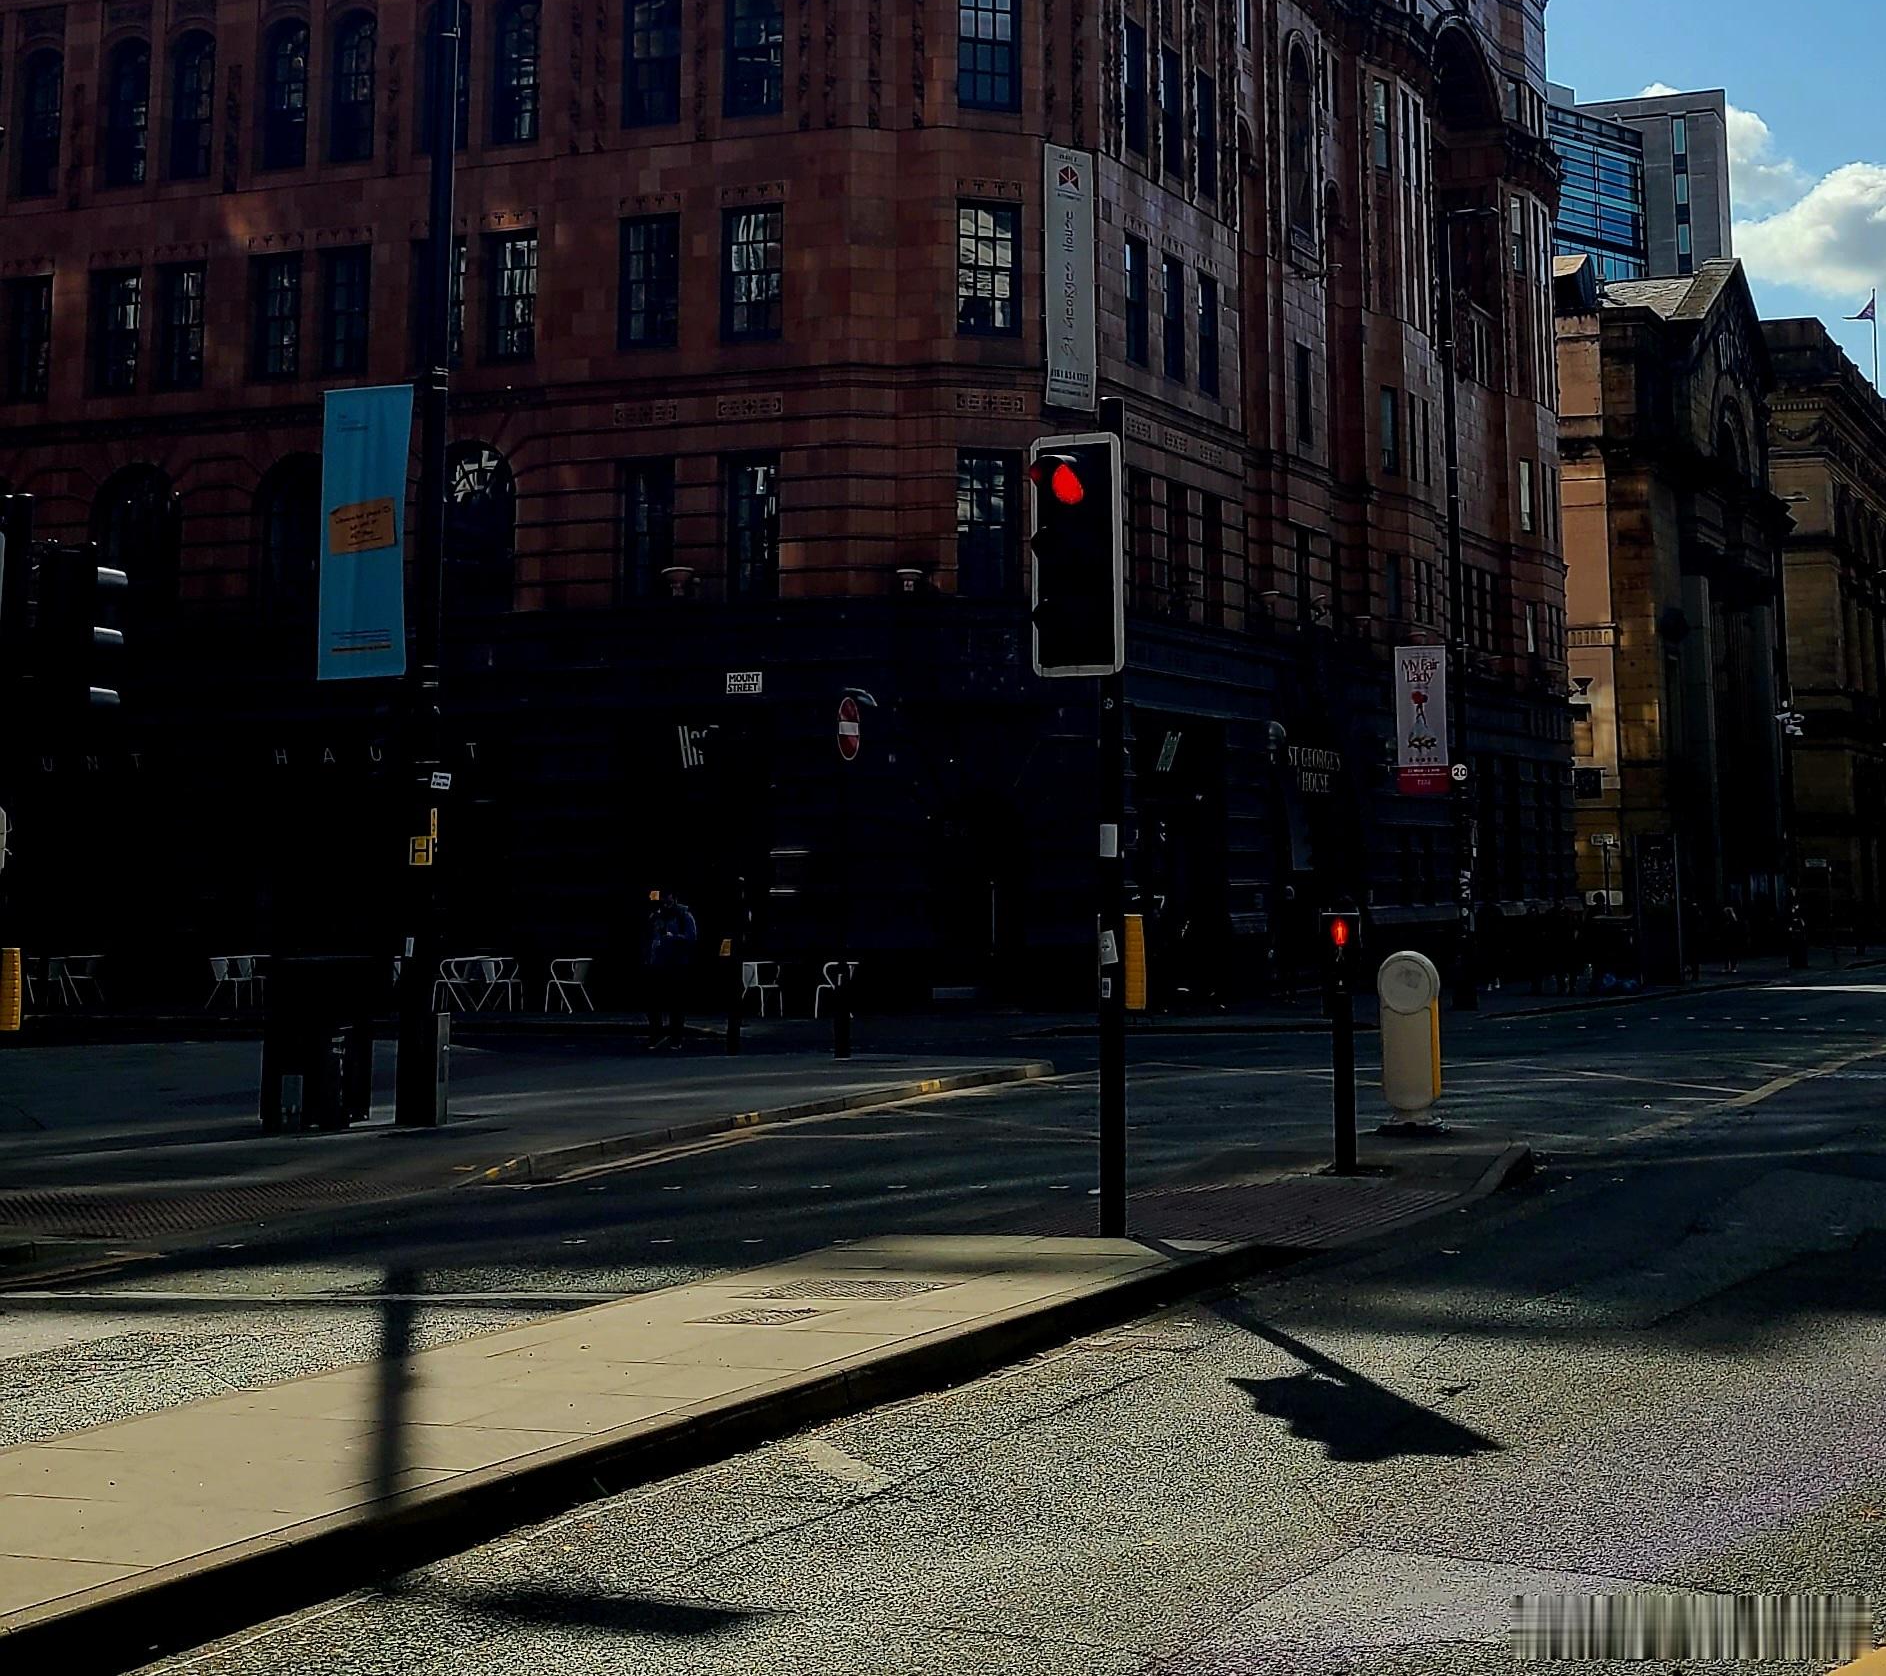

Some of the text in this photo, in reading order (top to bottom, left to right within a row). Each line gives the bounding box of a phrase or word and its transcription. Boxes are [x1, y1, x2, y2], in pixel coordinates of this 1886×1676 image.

[1402, 658, 1439, 673] My Fair
[728, 674, 760, 683] MOUNT
[1407, 670, 1433, 684] Lady
[728, 683, 758, 692] STREET
[1453, 767, 1467, 777] 20
[1302, 772, 1331, 793] HOUSE
